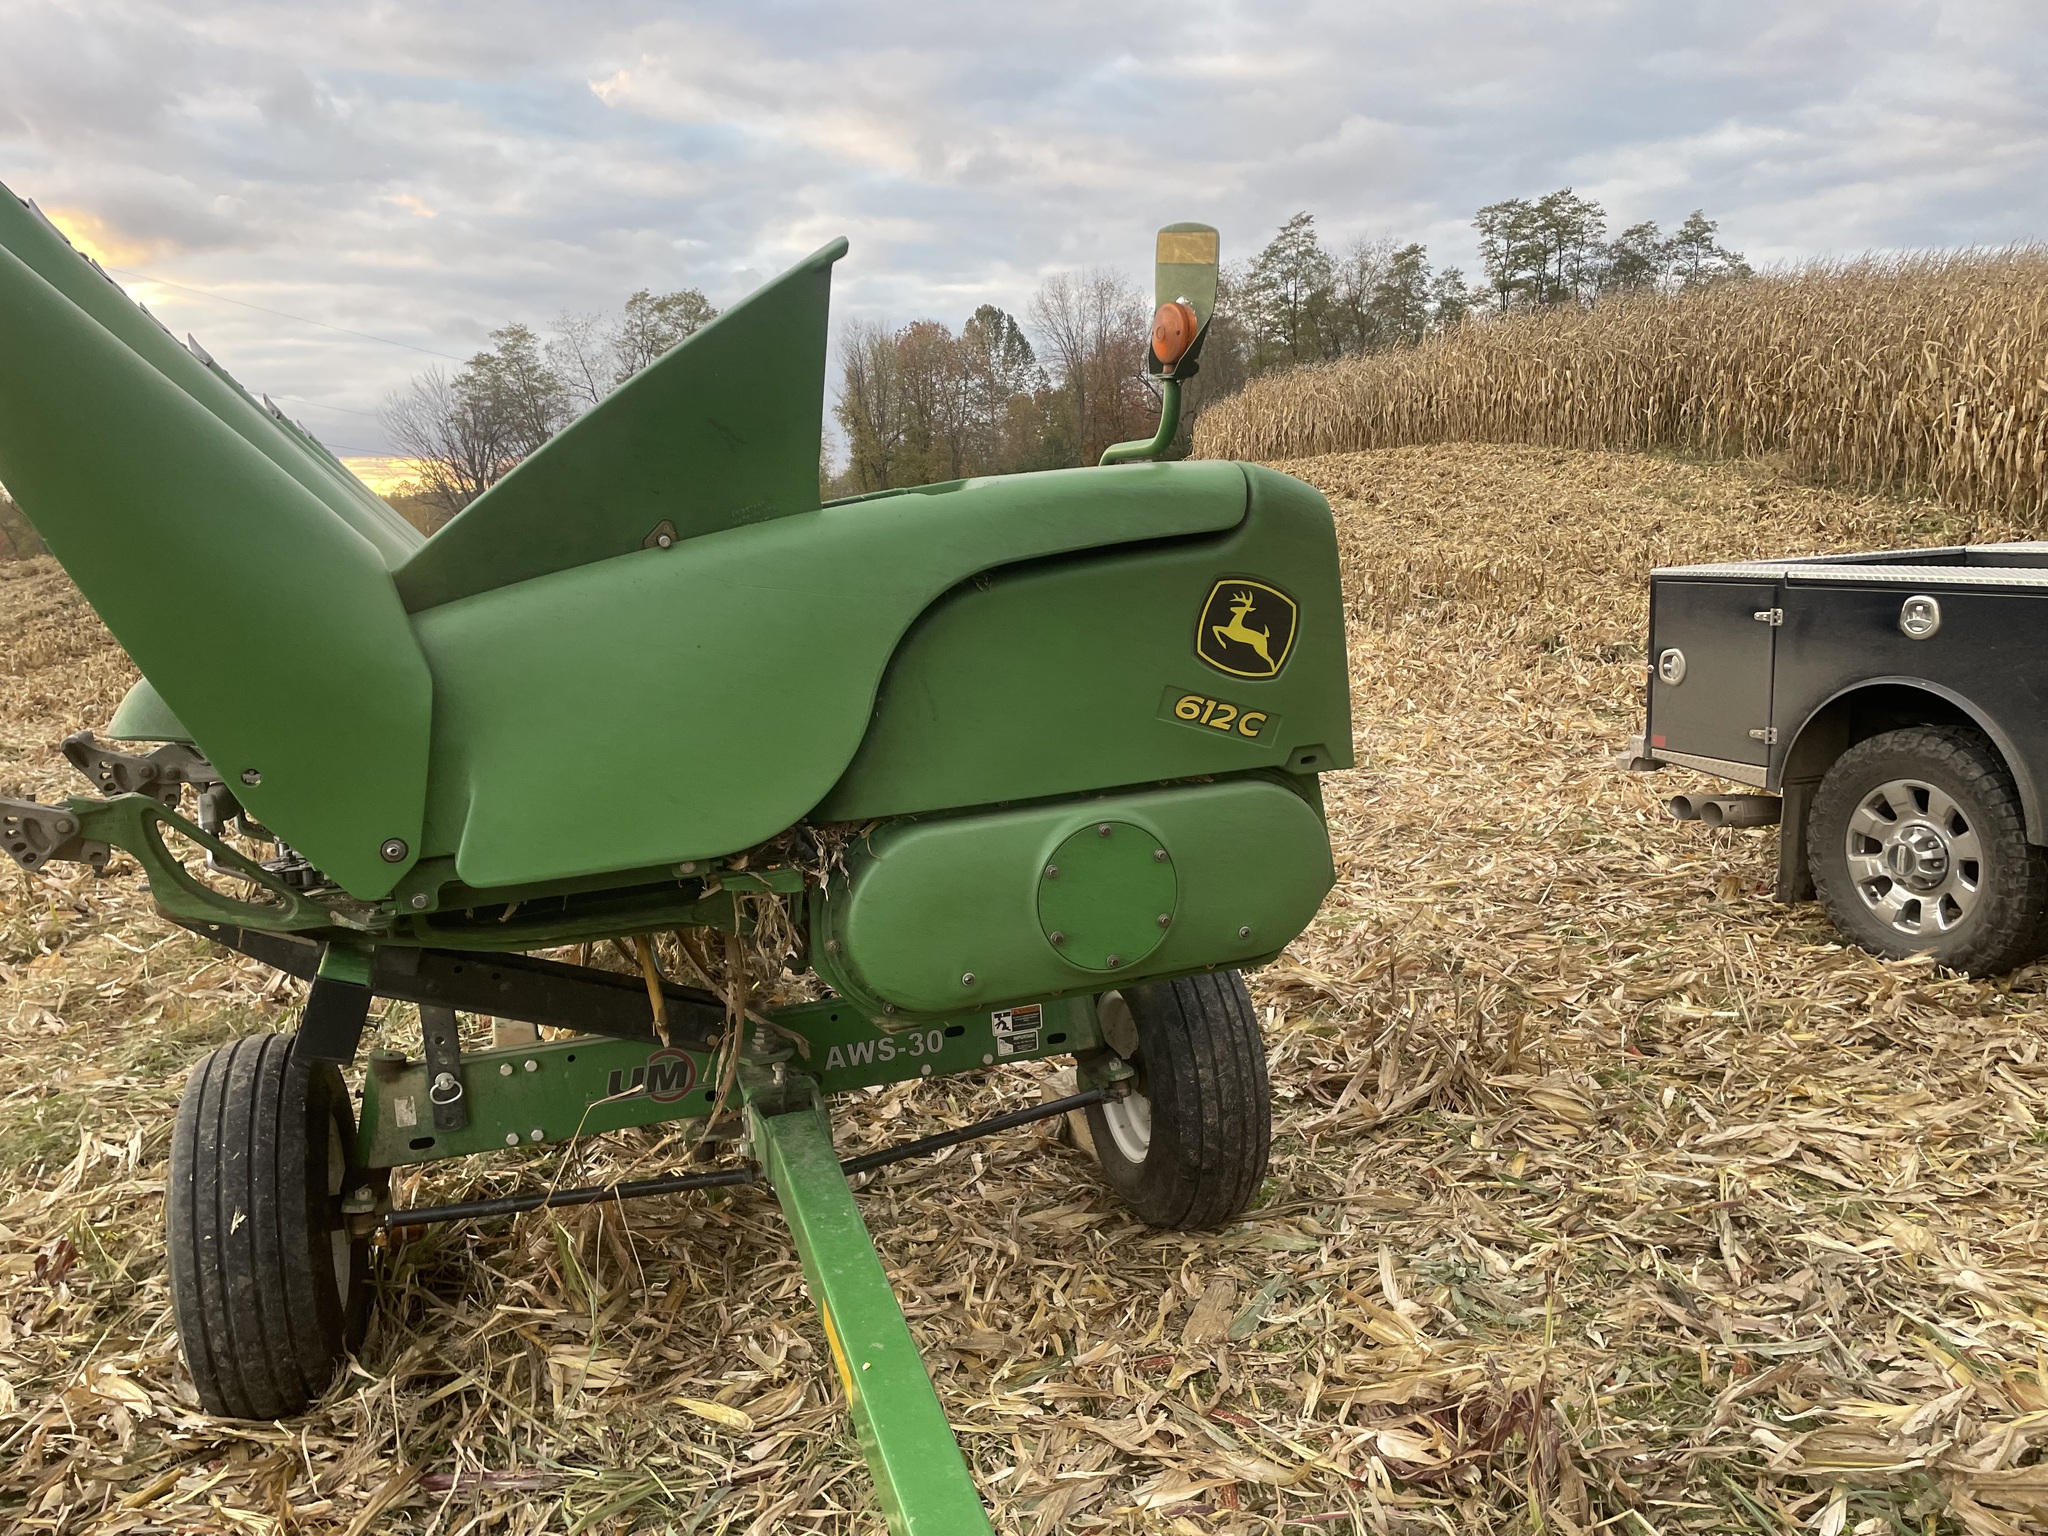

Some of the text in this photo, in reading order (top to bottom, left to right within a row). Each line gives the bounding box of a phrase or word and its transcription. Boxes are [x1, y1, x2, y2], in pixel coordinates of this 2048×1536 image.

[1174, 694, 1268, 738] 612C
[825, 1029, 944, 1071] AWS-30
[607, 1060, 689, 1098] UM
